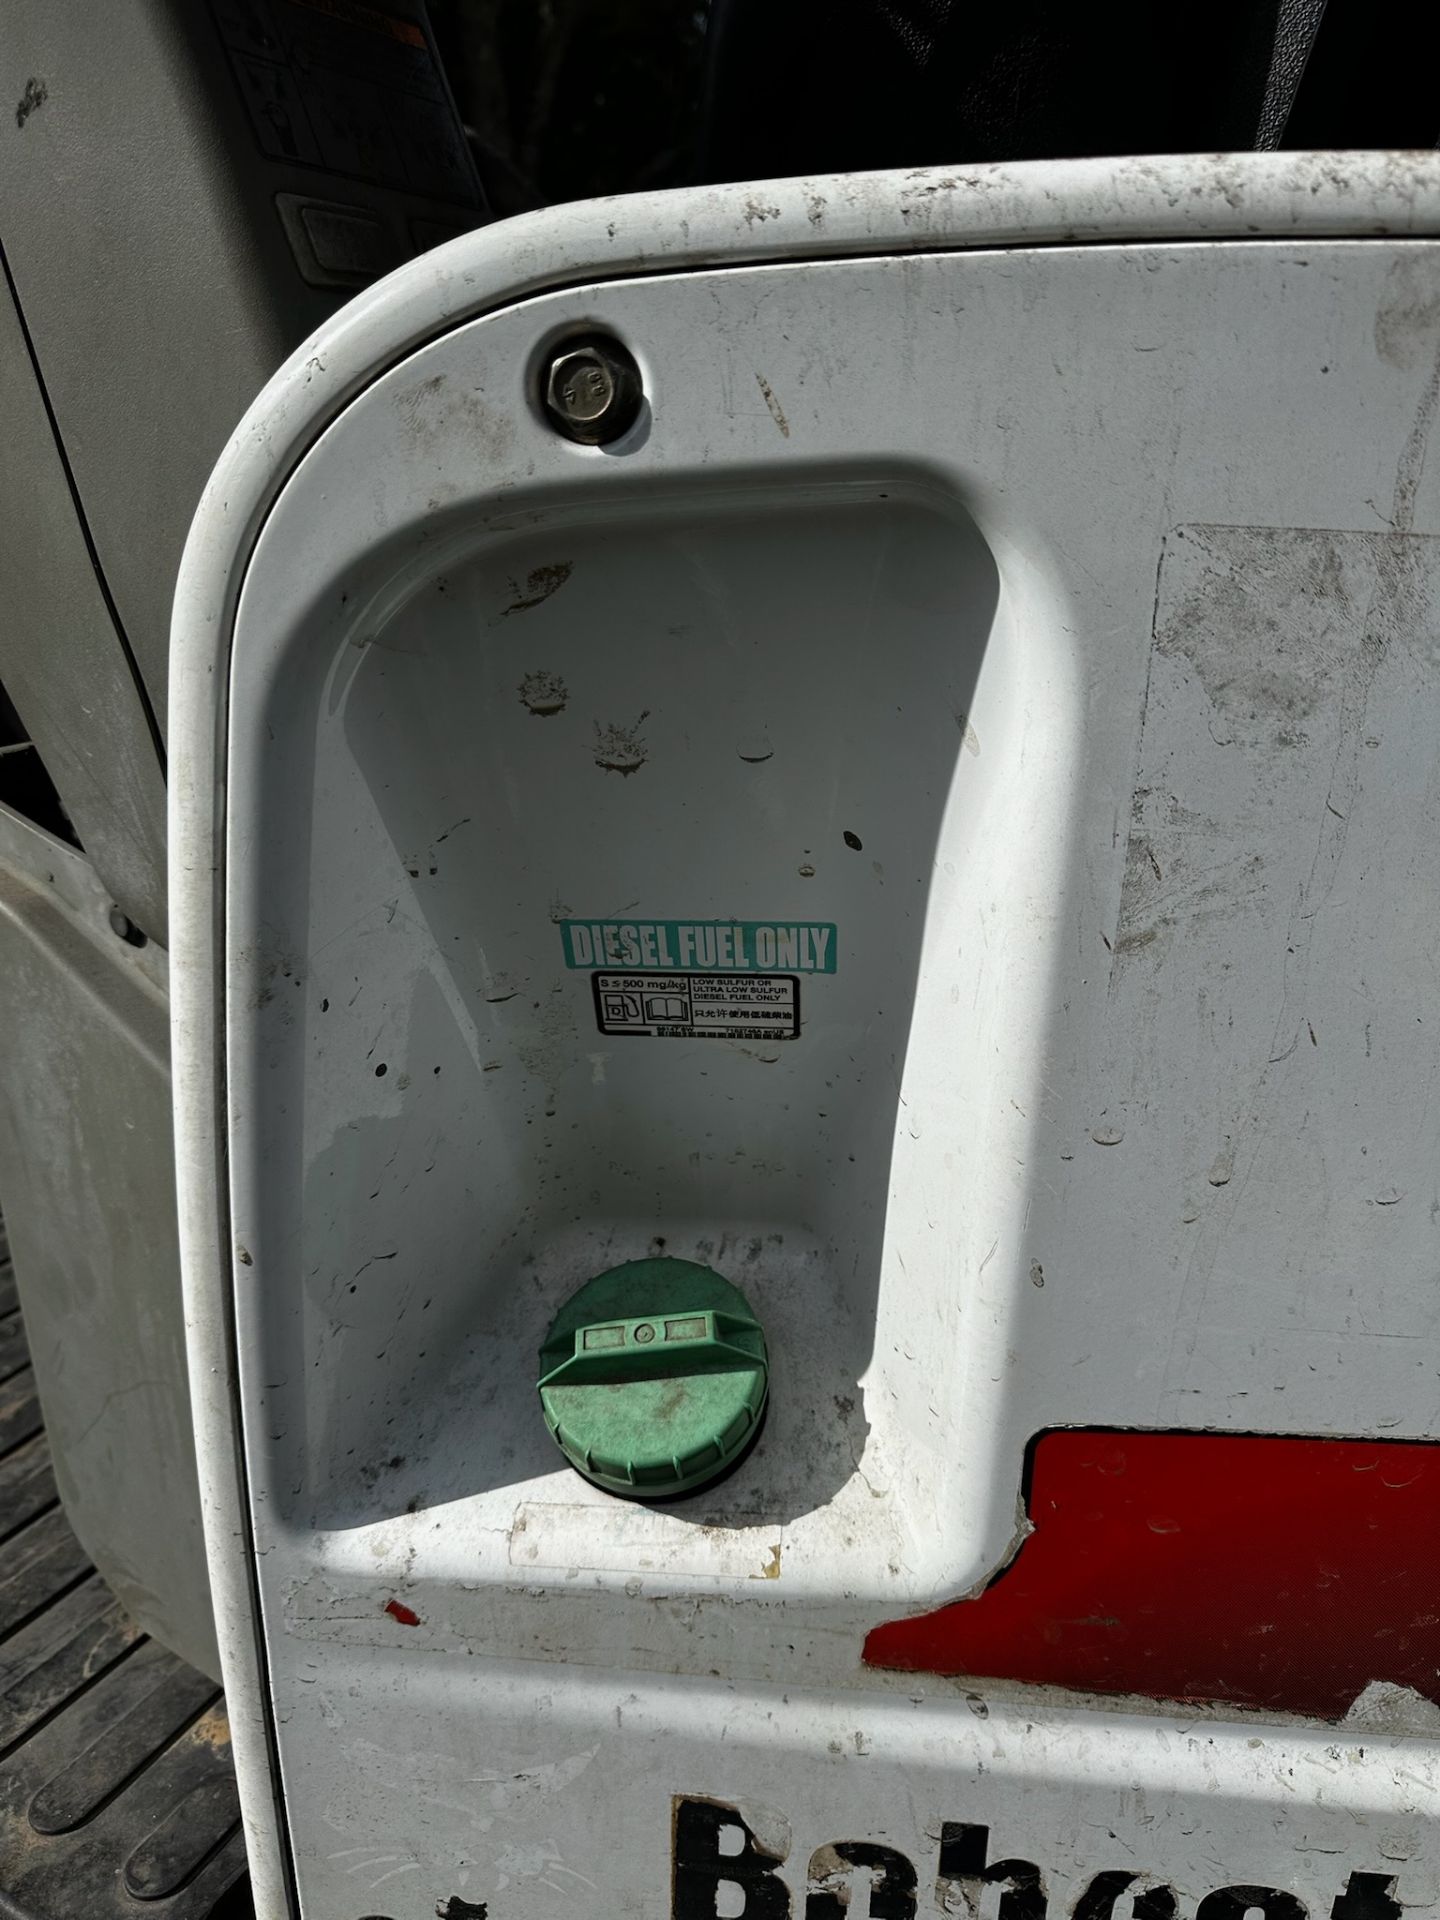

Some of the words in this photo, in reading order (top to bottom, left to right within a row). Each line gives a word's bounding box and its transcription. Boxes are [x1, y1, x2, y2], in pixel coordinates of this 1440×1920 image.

[569, 924, 674, 966] DIESEL
[678, 926, 749, 968] FUEL
[755, 927, 831, 970] ONLY
[600, 978, 609, 987] S
[623, 979, 644, 988] 500
[647, 979, 687, 991] mg/kg
